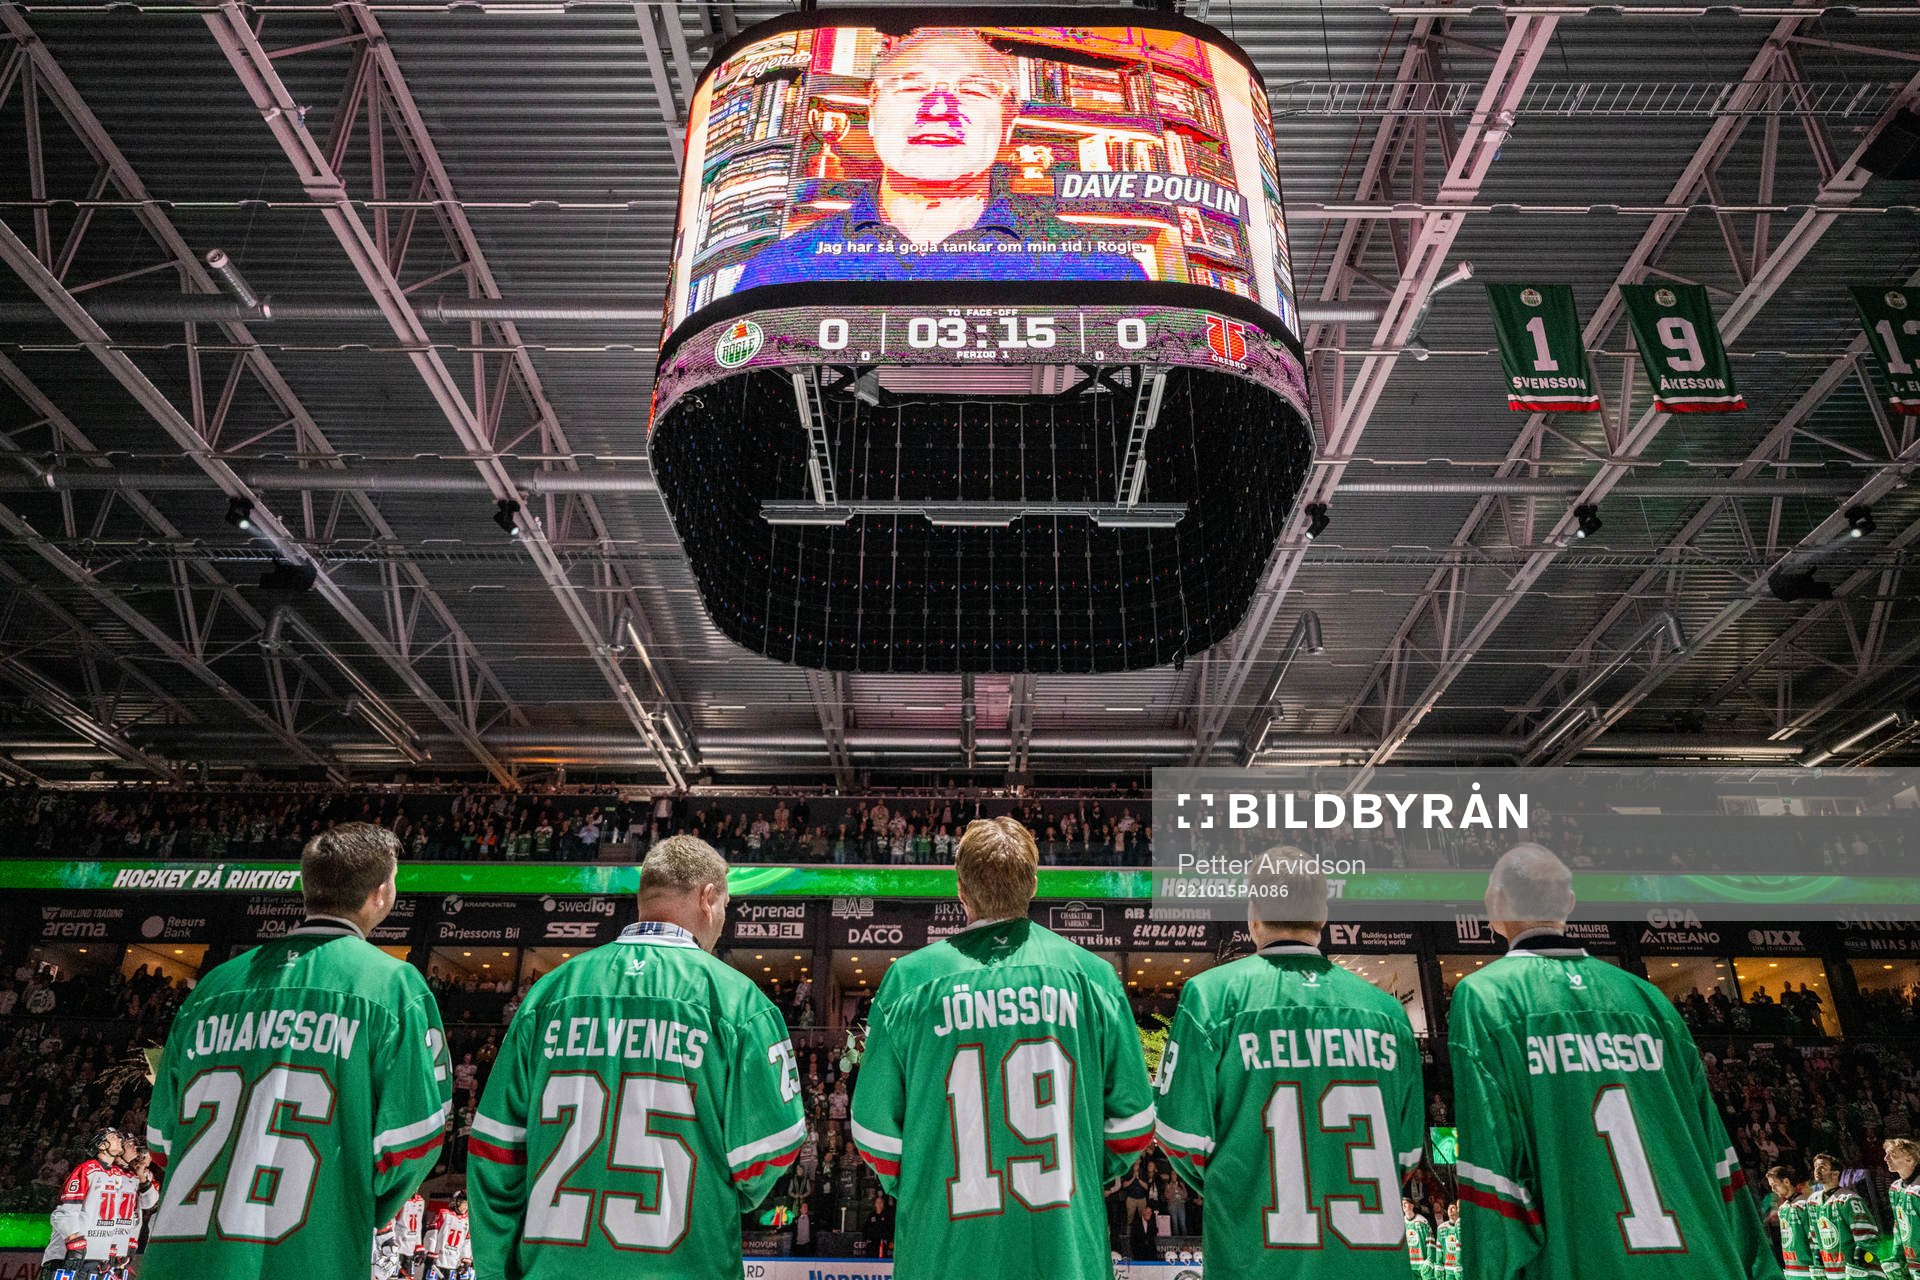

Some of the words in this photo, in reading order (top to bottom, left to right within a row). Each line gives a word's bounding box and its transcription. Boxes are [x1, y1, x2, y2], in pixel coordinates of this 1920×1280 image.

[1062, 173, 1138, 198] DAVE
[1144, 175, 1241, 216] POULIN
[816, 241, 842, 255] Jag
[847, 241, 871, 253] har
[877, 240, 895, 253] så
[900, 241, 938, 255] goda
[943, 241, 993, 253] tankar
[998, 243, 1022, 253] om
[1028, 241, 1057, 253] min
[1061, 241, 1082, 253] tid
[947, 309, 961, 317] TO
[966, 309, 1018, 317] FACE-OFF
[819, 319, 848, 349] 0
[908, 317, 1056, 349] 03:15
[1117, 319, 1147, 349] 0
[1526, 316, 1559, 372] 1
[1656, 316, 1706, 372] 9
[957, 351, 996, 359] PERIOD
[1003, 351, 1009, 359] 1
[1212, 354, 1247, 370] ÖREBRO
[1512, 375, 1587, 390] SVENSSON
[1660, 374, 1726, 390] ÅKESSON
[113, 869, 194, 888] HOCKEY
[192, 864, 225, 889] PÅ
[224, 870, 302, 889] RIKTIGT
[93, 908, 124, 919] TRADING
[558, 898, 616, 917] swedlog
[752, 903, 805, 921] prenad
[1125, 908, 1145, 919] AB
[167, 916, 206, 927] Resurs
[258, 919, 287, 932] JOA
[1580, 924, 1609, 932] MURR
[1646, 908, 1703, 930] GPA
[164, 927, 192, 938] Bank
[505, 927, 520, 939] Bil
[543, 922, 600, 938] SSE
[848, 928, 903, 944] DACO
[1133, 924, 1206, 938] EKBLADHS
[1329, 924, 1360, 944] EY
[1361, 931, 1387, 939] Building
[934, 984, 1078, 1038] JÖNSSON
[544, 1016, 709, 1069] S.ELVENES
[1238, 1028, 1398, 1071] R.ELVENES
[945, 1036, 1077, 1222] 19
[149, 1062, 337, 1245] 26
[522, 1070, 698, 1255] 25
[1261, 1080, 1406, 1251] 13
[1592, 1083, 1689, 1255] 1
[748, 1241, 777, 1249] NOVUM
